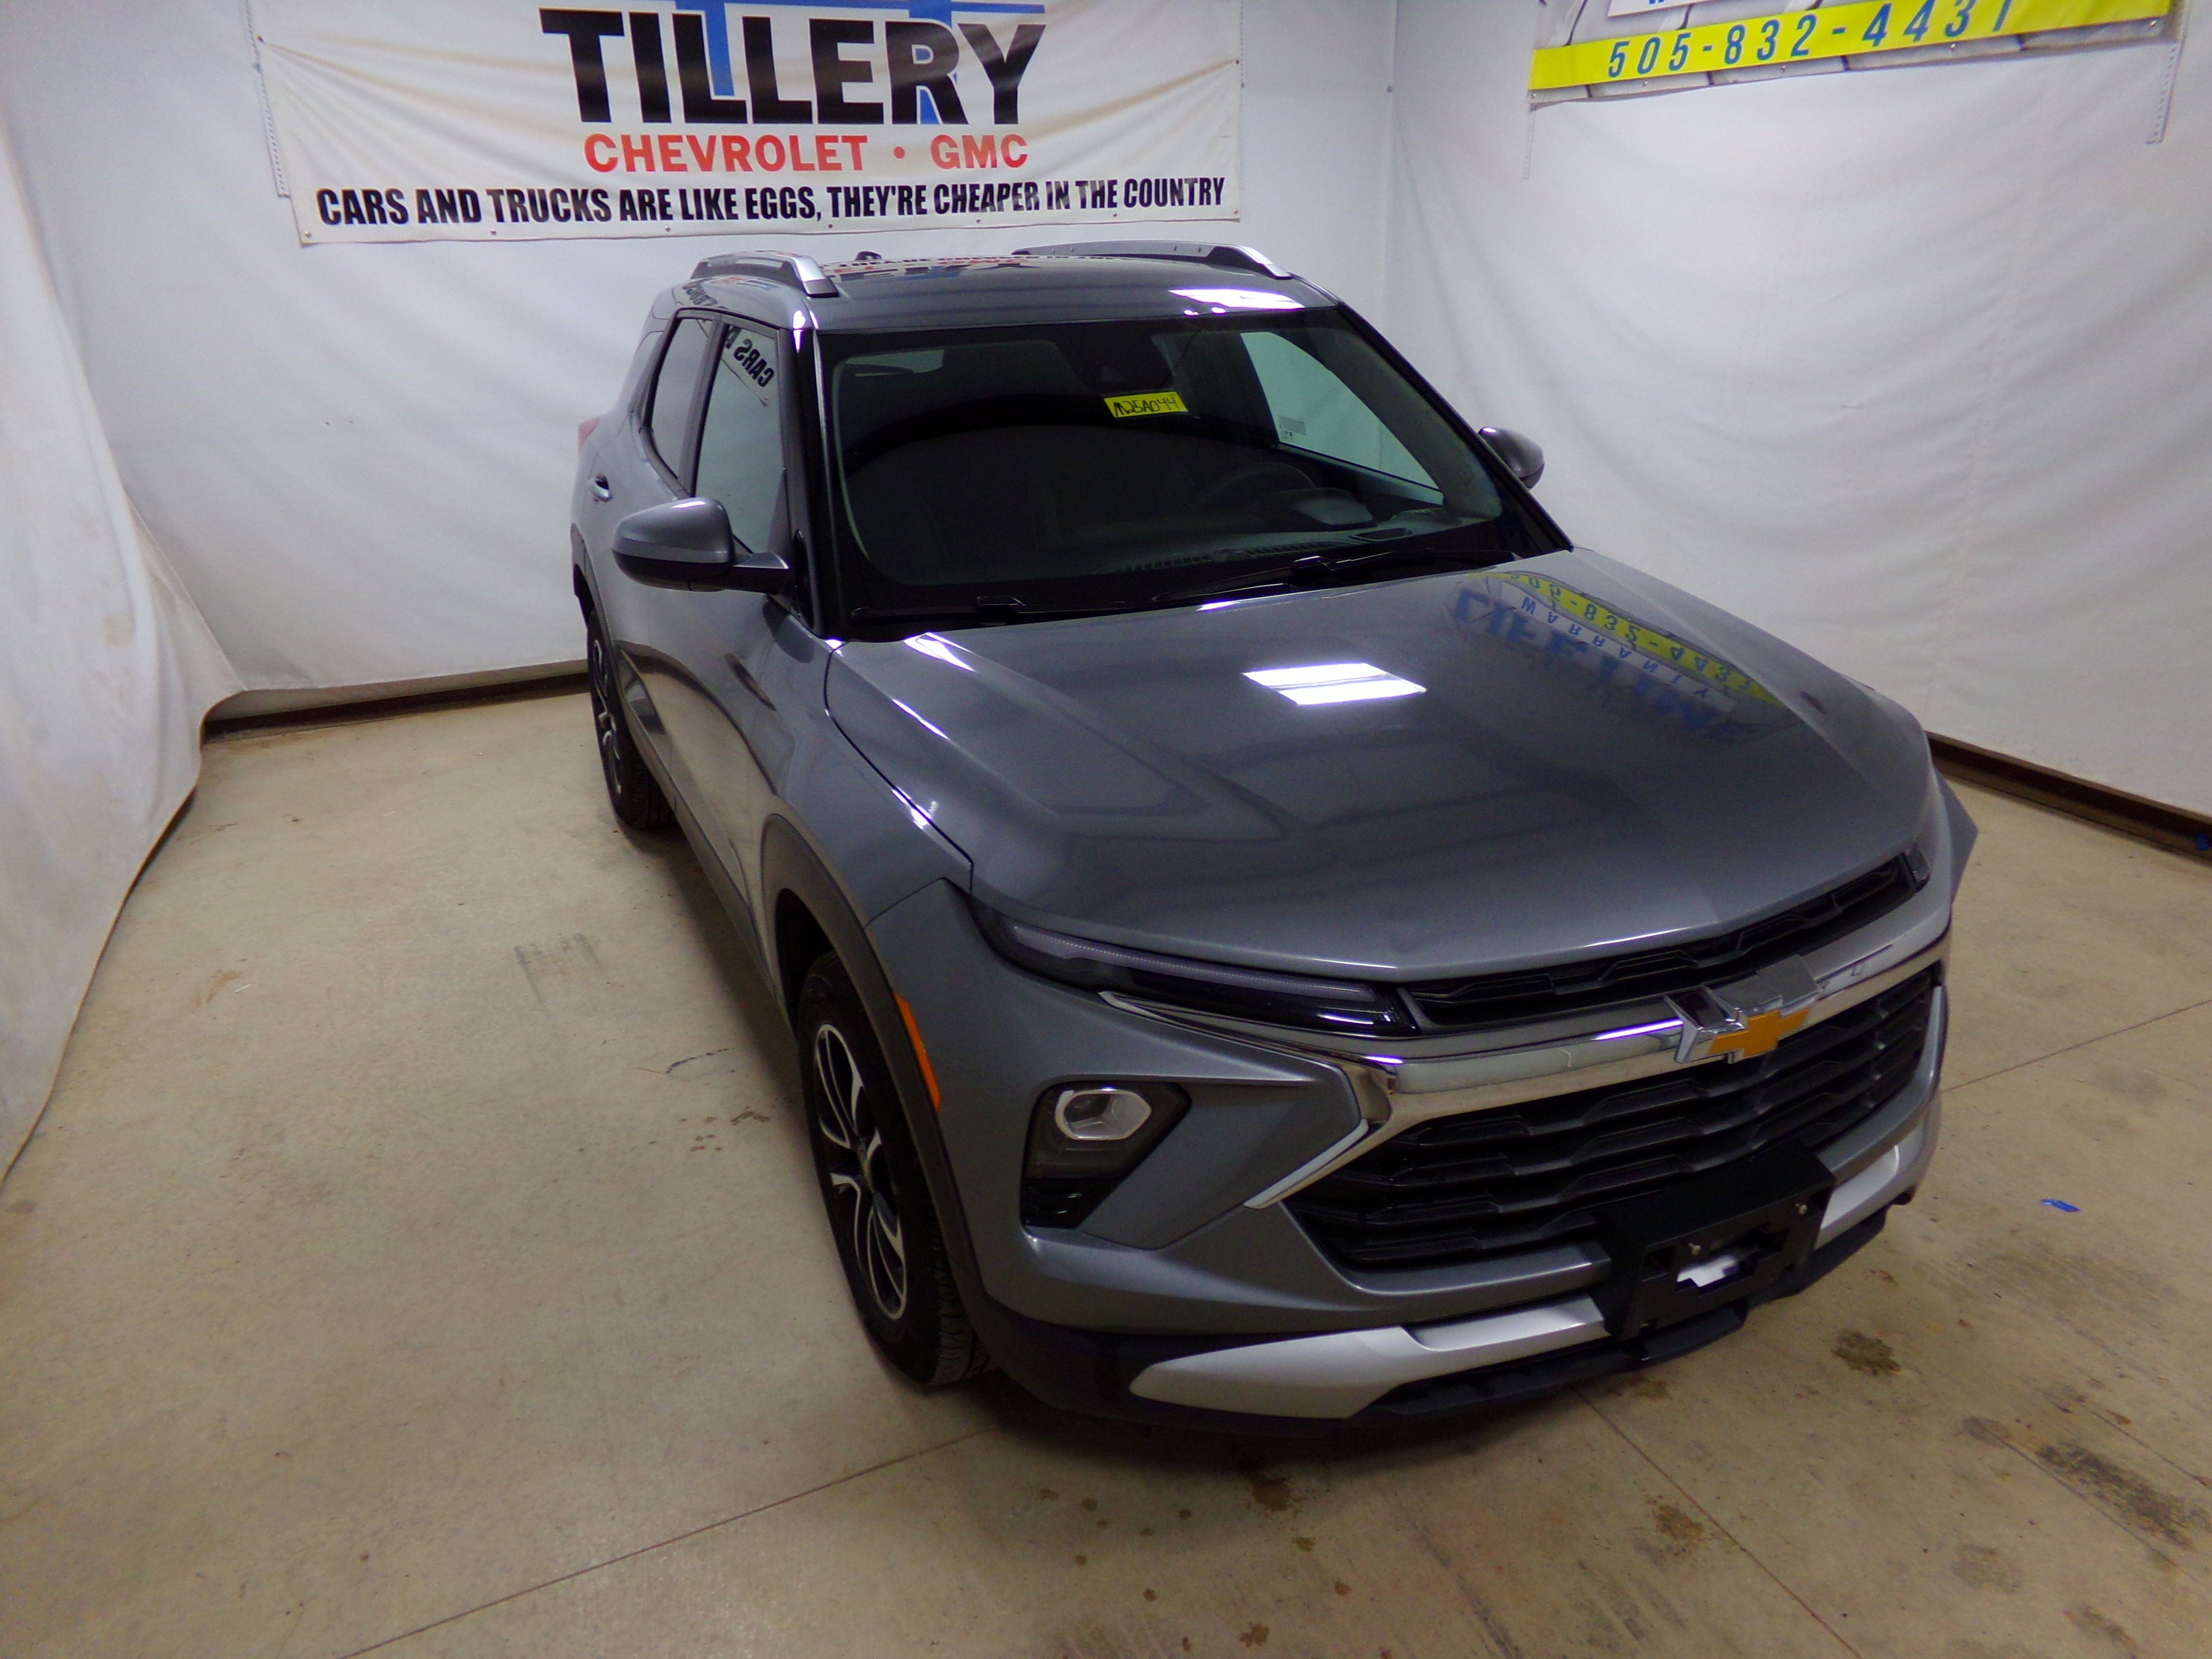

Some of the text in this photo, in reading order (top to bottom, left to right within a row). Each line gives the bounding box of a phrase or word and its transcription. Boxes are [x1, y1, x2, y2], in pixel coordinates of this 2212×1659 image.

[539, 8, 1046, 125] TILLERY
[1608, 0, 2012, 77] 505-832-4431
[584, 133, 1028, 172] CHEVROLET GMC
[316, 177, 1225, 225] CARS AND TRUCKS ARE LIKE EGGS, THEY'RE CHEAPER IN THE COUNTRY
